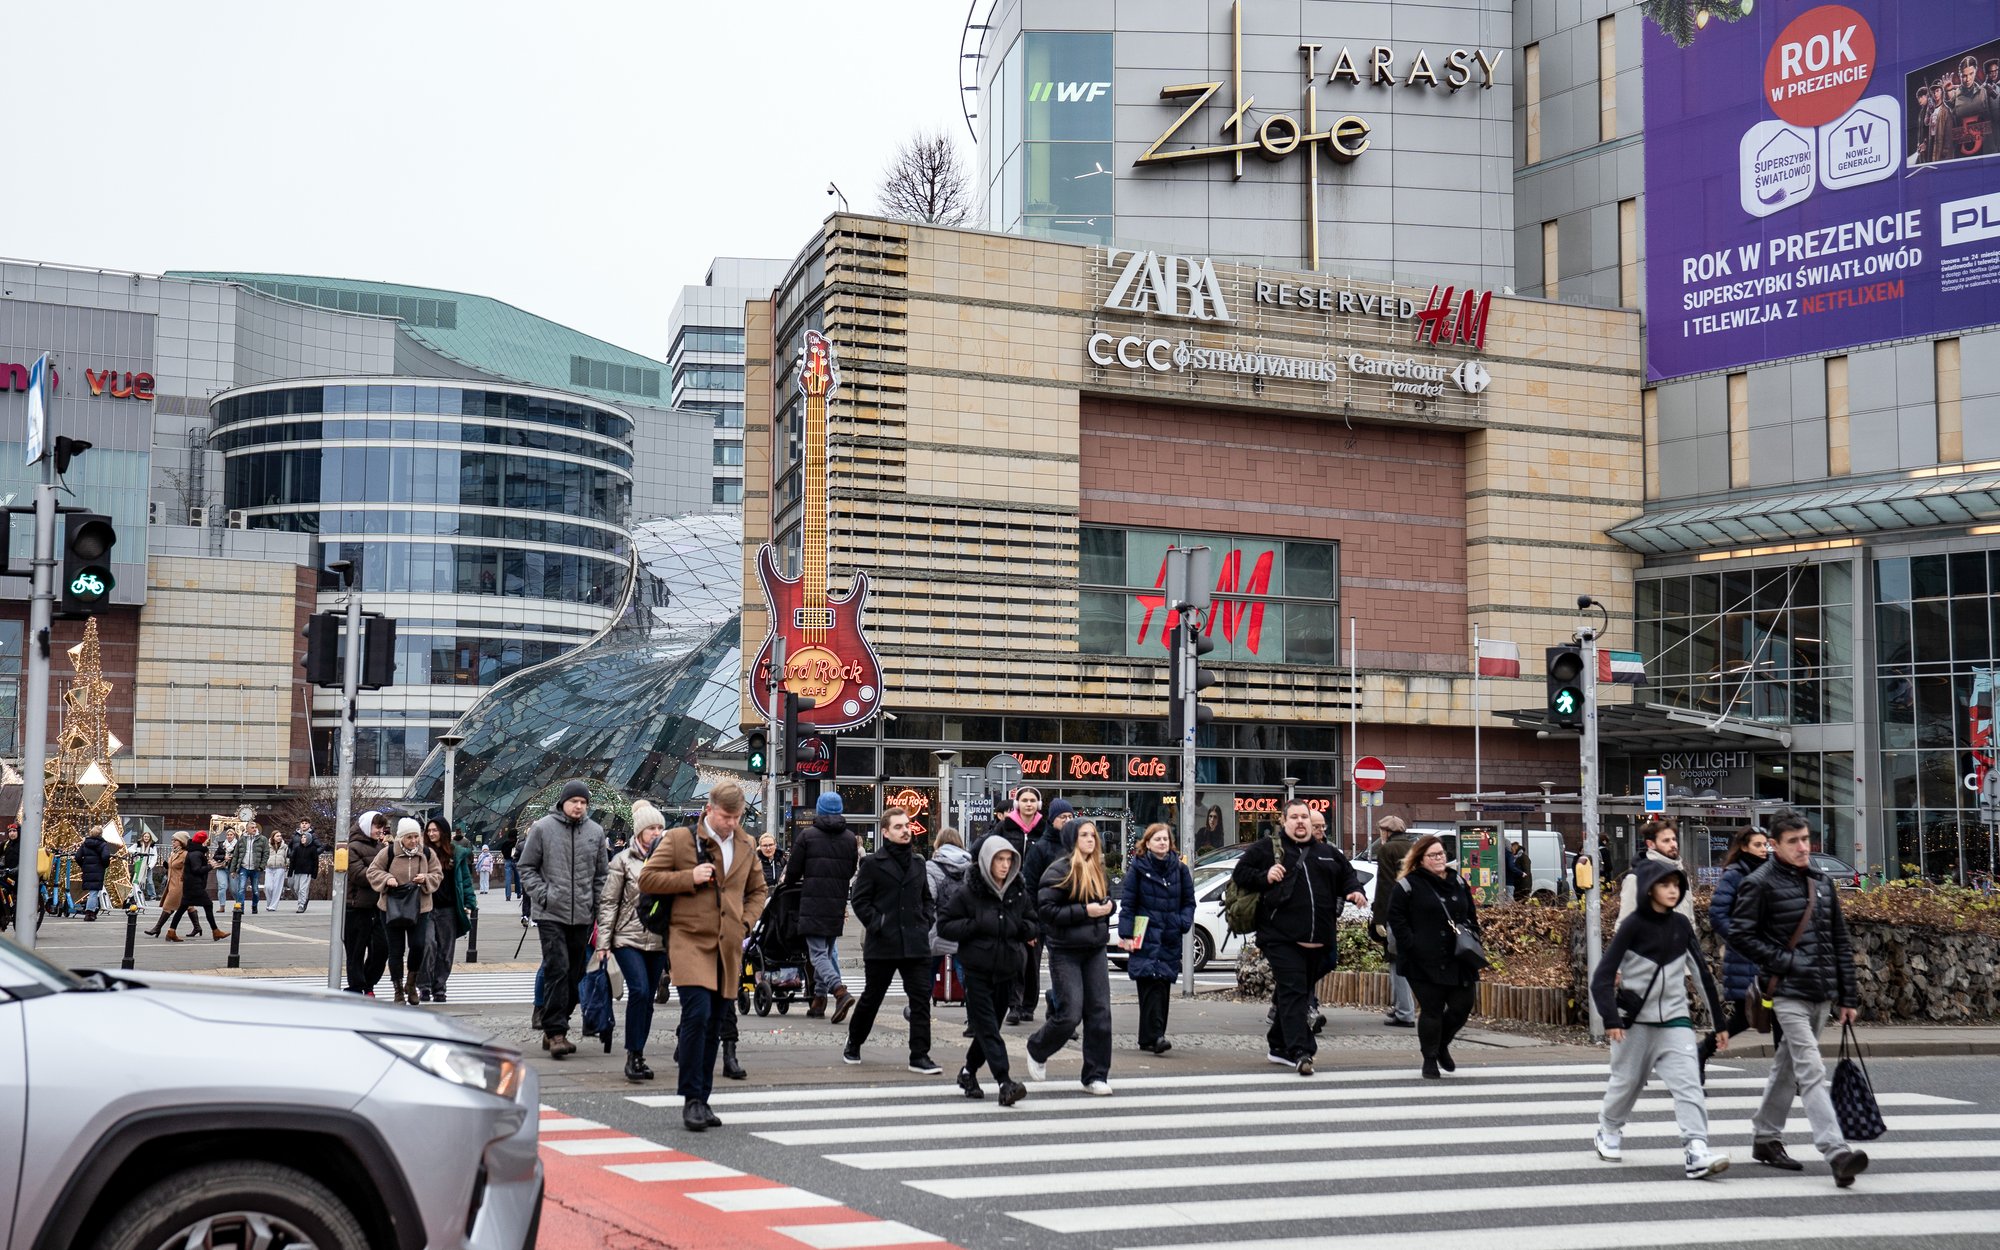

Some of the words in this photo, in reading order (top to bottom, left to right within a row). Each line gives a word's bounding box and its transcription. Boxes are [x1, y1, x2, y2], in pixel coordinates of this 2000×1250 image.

[1781, 25, 1857, 80] ROK
[1299, 43, 1504, 91] TARASY
[1771, 86, 1784, 102] W
[1788, 64, 1868, 98] PREZENCIE
[1845, 122, 1874, 148] TV
[1754, 151, 1812, 174] SUPERSZYBKI
[1838, 154, 1881, 171] GENERACJI
[1845, 146, 1873, 159] NOWEJ
[1754, 163, 1812, 189] ŚWIATŁOWÓD
[1682, 249, 1732, 284] ROK
[1738, 242, 1761, 272] W
[1769, 208, 1922, 267] PREZENCIE
[1103, 248, 1237, 322] ZARA
[1683, 272, 1793, 311] SUPERSZYBKI
[1795, 246, 1923, 288] ŚWIATŁOWÓD
[1256, 281, 1415, 319] RESERVED
[1683, 320, 1690, 337] I
[1692, 301, 1783, 336] TELEWIZJA
[1786, 299, 1798, 319] Z
[1802, 279, 1905, 316] NETFLIXEM
[1414, 284, 1493, 350] H&M
[1087, 332, 1172, 372] CCC
[1193, 348, 1337, 383] STRADIVARIUS
[1348, 352, 1448, 382] Carrefour
[86, 368, 155, 400] vue
[1392, 380, 1443, 398] market
[815, 659, 863, 684] Rock
[801, 686, 827, 696] CAFE
[1069, 754, 1110, 779] Rock
[1128, 756, 1166, 777] Cafe
[1661, 751, 1749, 770] SKYLIGHT
[1680, 769, 1728, 779] globalworth
[886, 795, 909, 808] Hard
[908, 795, 929, 808] Rock
[1233, 797, 1278, 811] ROCK
